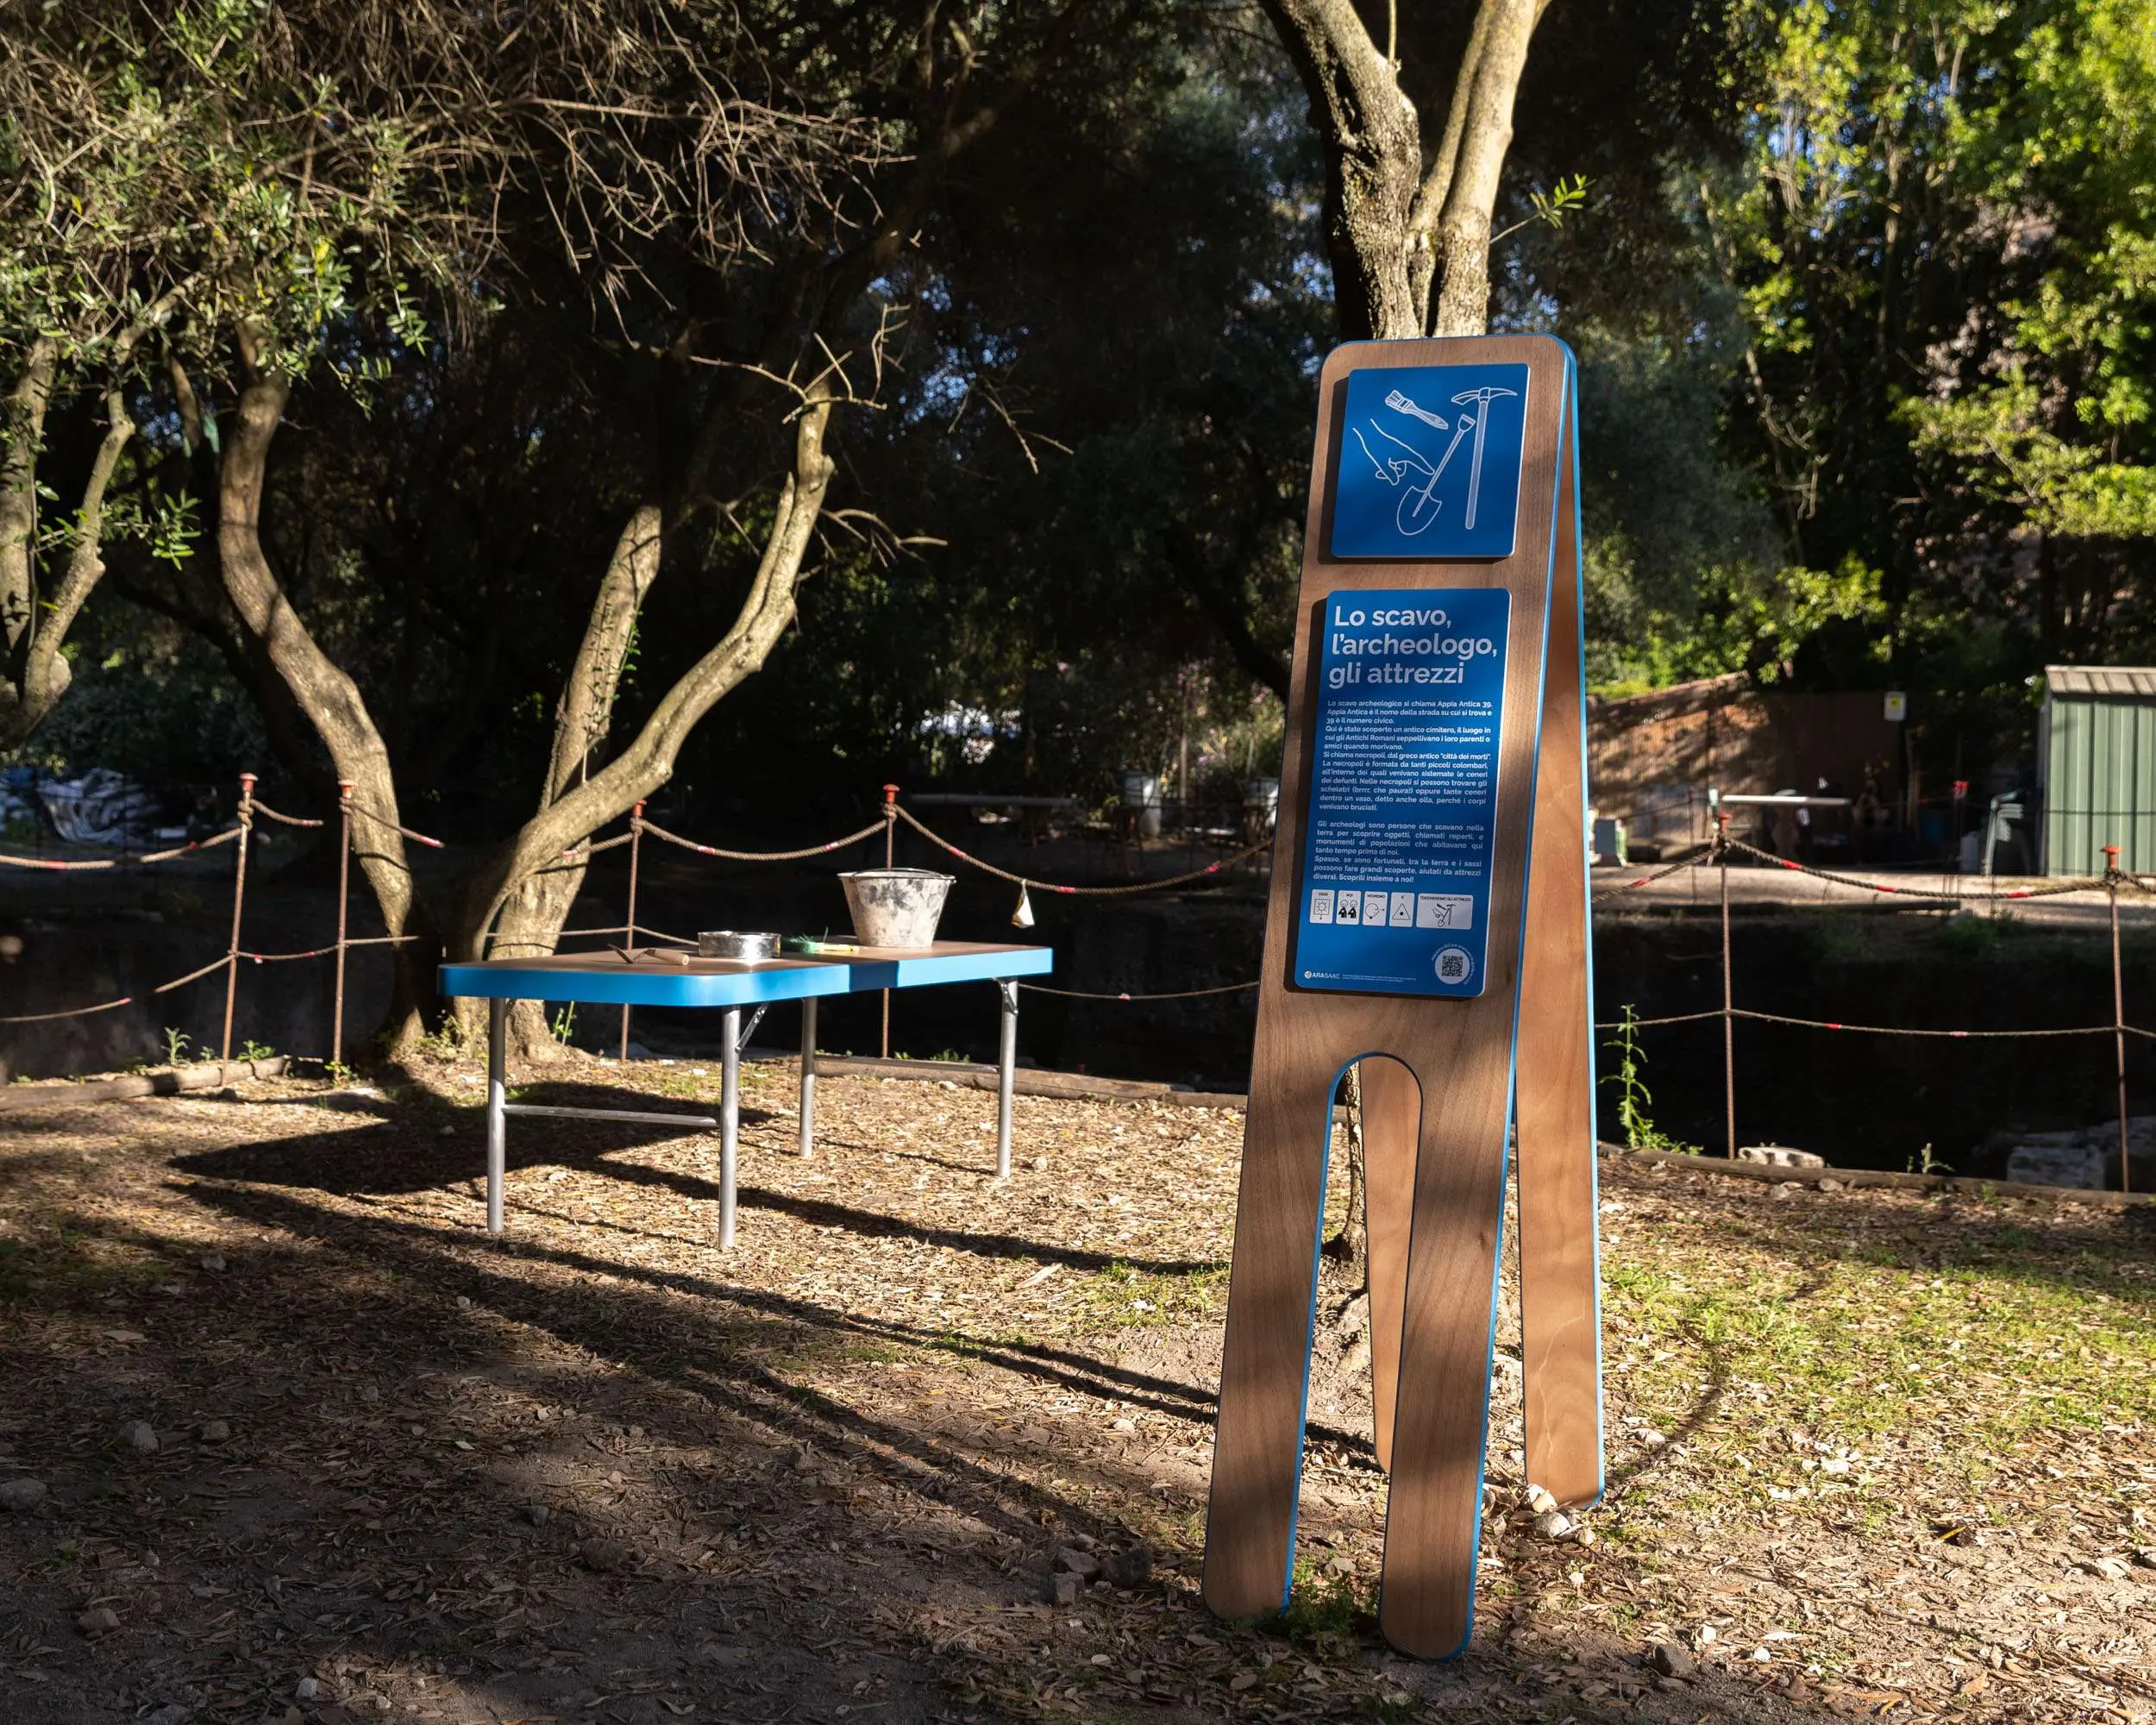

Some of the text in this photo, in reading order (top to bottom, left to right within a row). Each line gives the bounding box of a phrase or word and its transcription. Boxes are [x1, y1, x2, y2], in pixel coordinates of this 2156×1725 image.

[1335, 606, 1451, 628] Lo scavo,
[1332, 634, 1497, 660] l'archeologo,
[1329, 662, 1464, 689] gli attrezzi
[1358, 700, 1402, 709] archeologico
[1437, 700, 1457, 709] Appia
[1327, 708, 1345, 717] Appia
[1326, 717, 1334, 725] 39
[1362, 725, 1392, 734] scoperto
[1426, 726, 1455, 735] cimitero,
[1462, 726, 1483, 735] luogo
[1336, 734, 1344, 743] gli
[1396, 735, 1440, 744] seppellivano
[1459, 735, 1484, 744] parenti
[1343, 743, 1368, 751] quando
[1332, 760, 1363, 769] necropoli
[1428, 761, 1450, 770] piccoli
[1452, 761, 1488, 770] colombari,
[1370, 769, 1386, 778] quali
[1379, 778, 1411, 787] necropoli
[1477, 780, 1487, 788] gli
[1419, 796, 1433, 805] olla,
[1468, 797, 1485, 806] corpi
[1329, 821, 1365, 830] archeologi
[1353, 830, 1380, 839] scoprire
[1370, 839, 1409, 849] popolazioni
[1471, 842, 1482, 851] qui
[1334, 847, 1356, 856] tempo
[1358, 848, 1377, 857] prima
[1360, 866, 1382, 875] grandi
[1339, 874, 1364, 883] Scoprili
